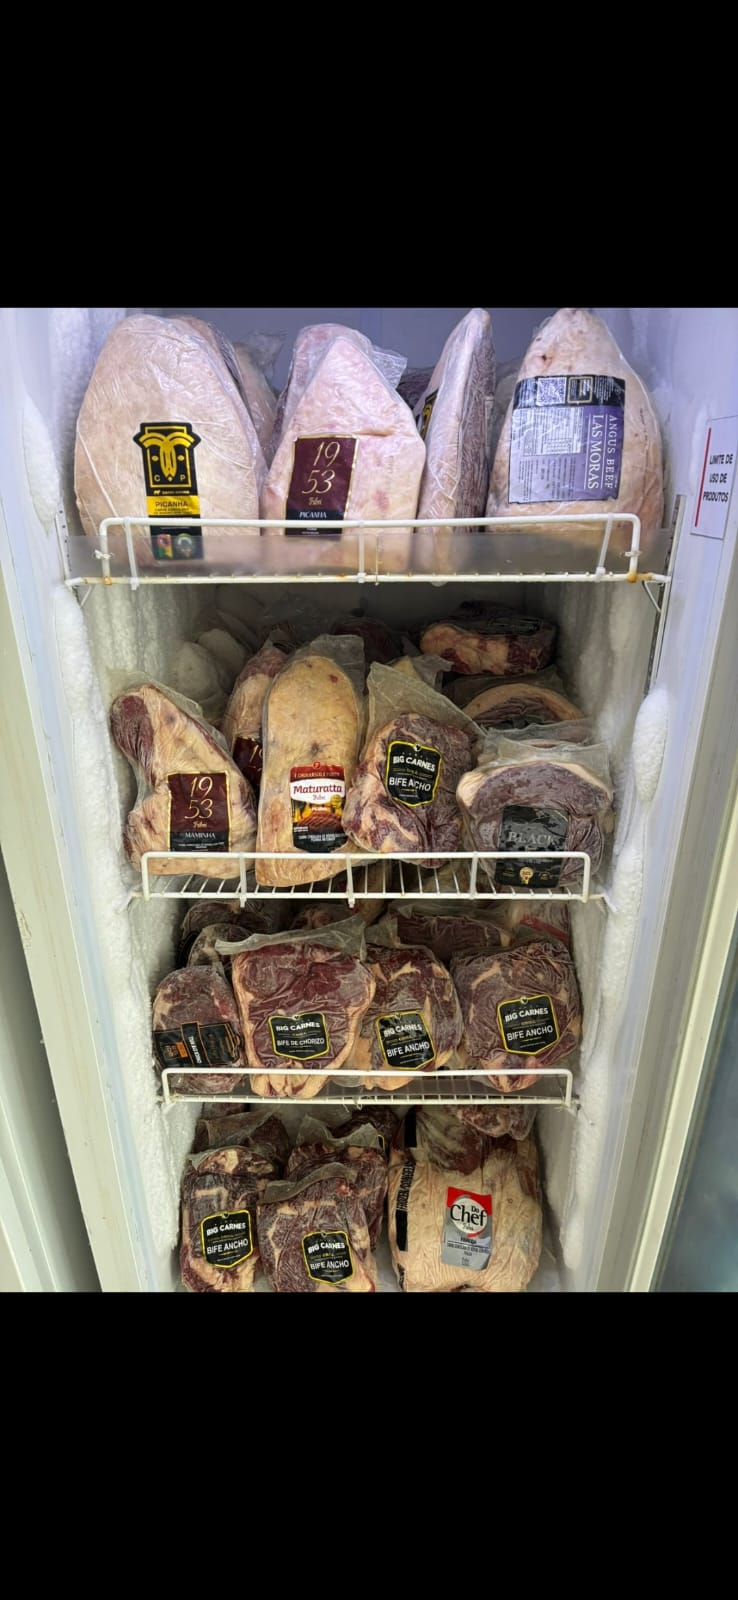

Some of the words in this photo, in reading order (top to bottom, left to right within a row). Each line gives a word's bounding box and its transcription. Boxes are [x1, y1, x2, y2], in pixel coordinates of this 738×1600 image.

[592, 414, 604, 438] LAS
[607, 415, 618, 454] ANGUS
[313, 441, 341, 467] 19
[709, 454, 725, 465] LIMITE
[725, 454, 733, 464] DE
[587, 441, 602, 489] MORAS
[301, 469, 336, 494] 53
[604, 458, 614, 489] BEEF
[709, 473, 719, 483] USO
[719, 473, 728, 483] DE
[703, 491, 729, 502] PRODUTOS
[392, 755, 405, 764] BIG
[405, 756, 436, 772] CARNES
[190, 776, 213, 798] 19
[293, 784, 342, 794] Maturatta
[389, 777, 408, 787] BIFE
[184, 798, 213, 819] 53
[504, 1012, 518, 1023] BIG
[518, 1007, 549, 1018] CARNES
[290, 1021, 321, 1031] CARNES
[383, 1027, 395, 1038] BIG
[395, 1024, 422, 1033] CARNES
[506, 1030, 525, 1041] BIFE
[525, 1025, 553, 1037] ANCHO
[299, 1038, 325, 1046] CHORIZO
[386, 1046, 404, 1057] BIFE
[404, 1041, 430, 1053] ANCHO
[450, 1204, 488, 1226] Chef
[471, 1205, 480, 1213] Do
[206, 1226, 219, 1236] BIG
[219, 1222, 246, 1232] CARNES
[206, 1244, 223, 1255] BIFE
[223, 1238, 249, 1251] ANCHO
[307, 1243, 320, 1254] BIG
[310, 1261, 326, 1270] BIFE
[326, 1259, 350, 1269] ANCHO
